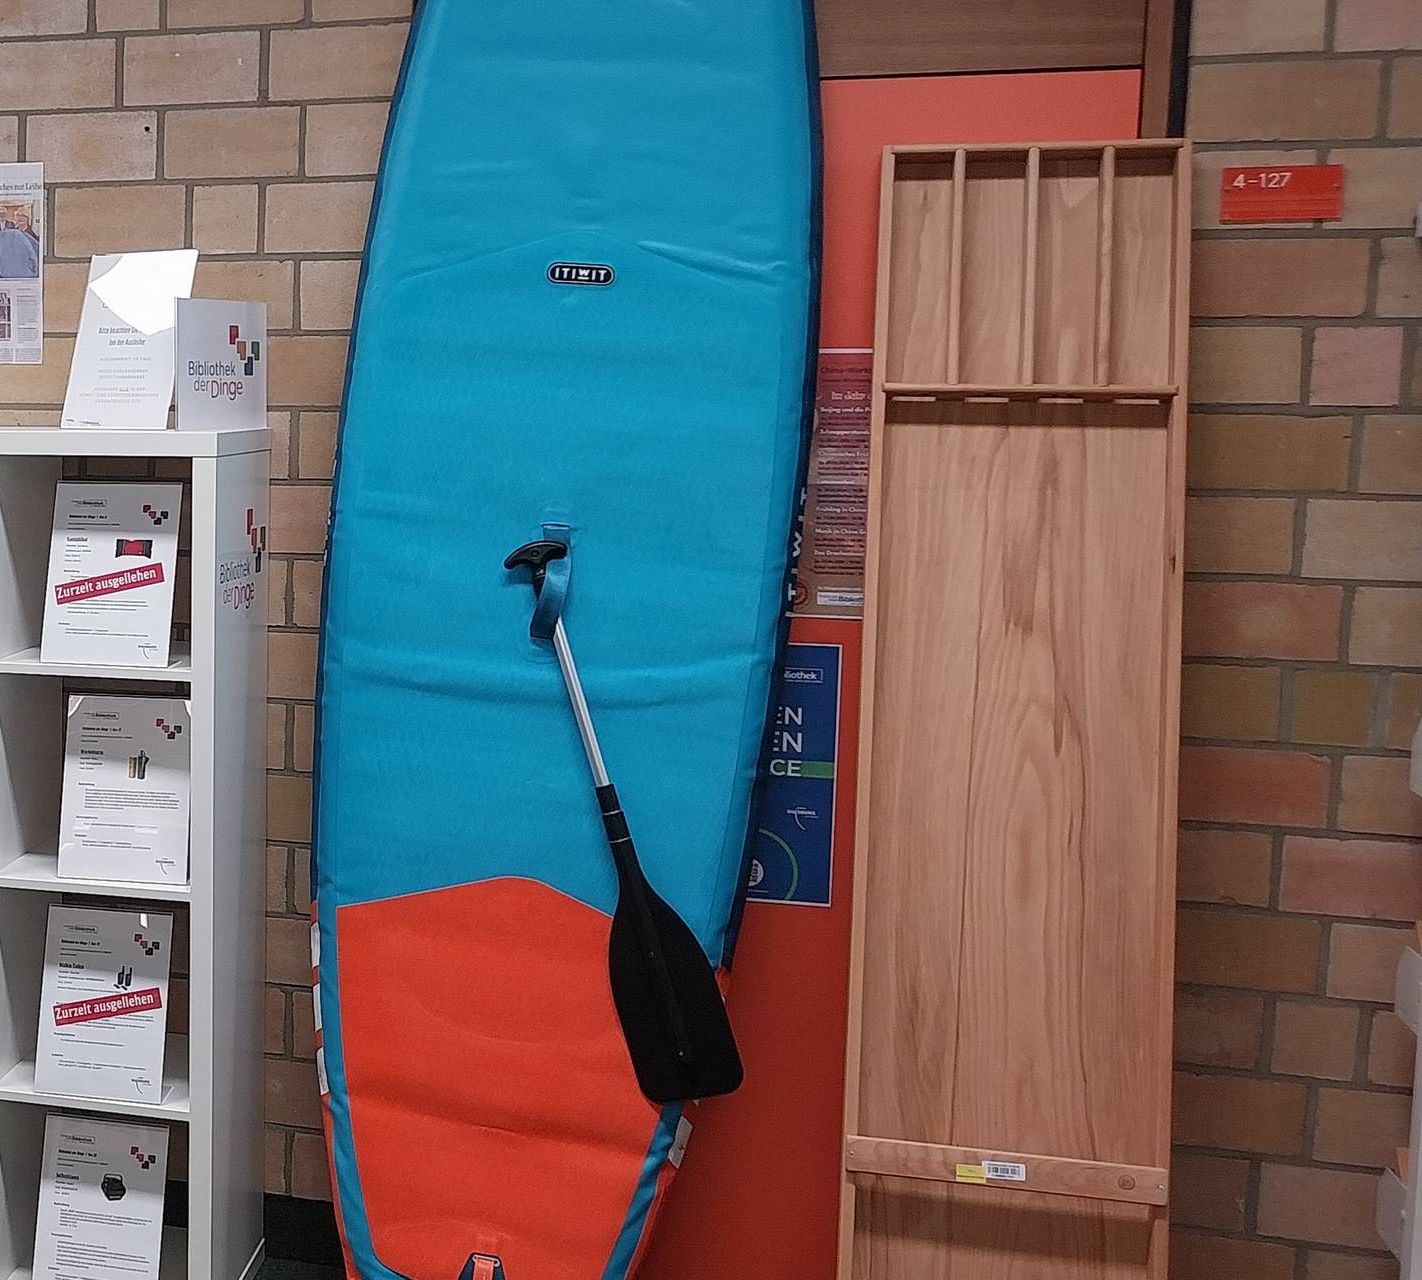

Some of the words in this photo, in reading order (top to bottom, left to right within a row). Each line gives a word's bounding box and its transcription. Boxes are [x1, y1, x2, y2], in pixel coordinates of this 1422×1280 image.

[1233, 172, 1292, 189] 4-127
[555, 267, 607, 282] ITIWIT
[188, 360, 236, 376] Bibliothek
[194, 378, 209, 392] der
[211, 380, 243, 401] Dinge
[219, 557, 252, 585] Bibliothek
[56, 577, 94, 600] Zurzeit
[95, 568, 156, 592] ausgeliehen
[233, 582, 255, 610] Dinge
[54, 1002, 92, 1020] Zurzeit
[93, 992, 154, 1013] ausgeliehen
